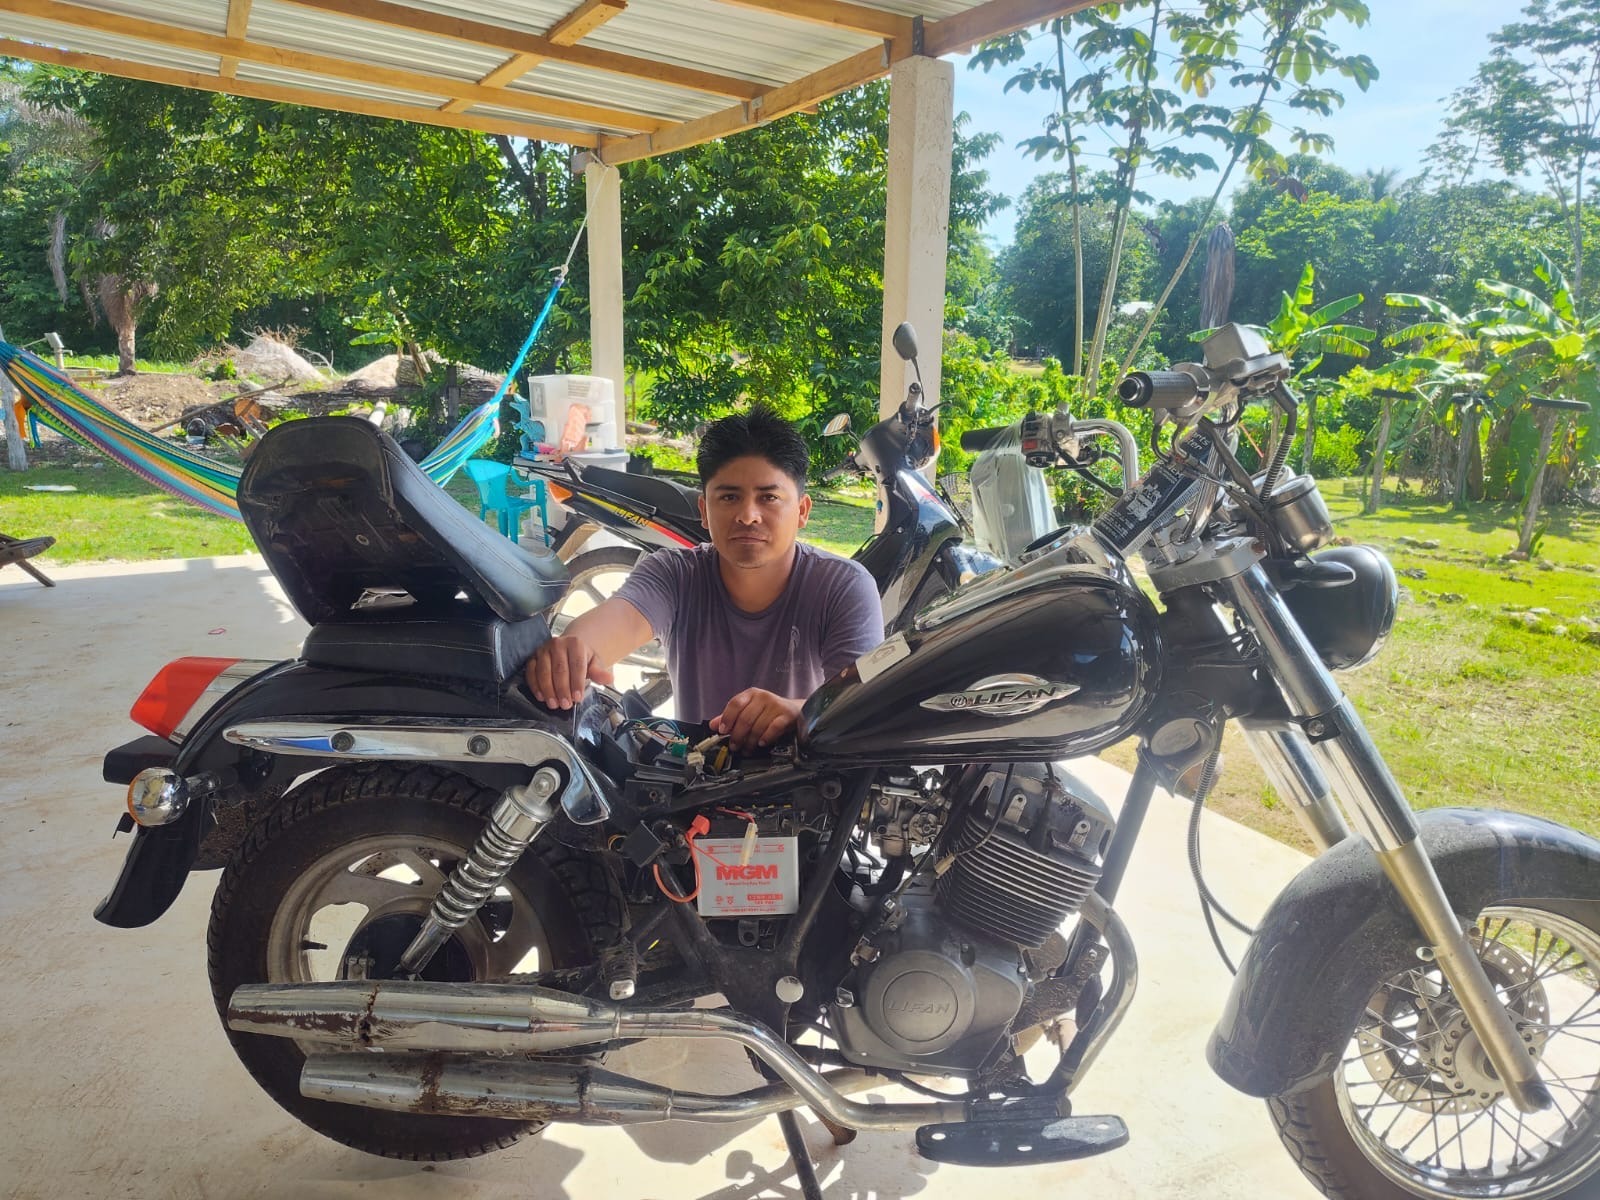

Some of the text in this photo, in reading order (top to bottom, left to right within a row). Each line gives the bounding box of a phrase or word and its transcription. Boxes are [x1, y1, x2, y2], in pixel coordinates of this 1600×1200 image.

[973, 686, 1056, 704] LIFAN
[716, 864, 778, 880] MGM
[887, 1000, 950, 1015] LIFAN
